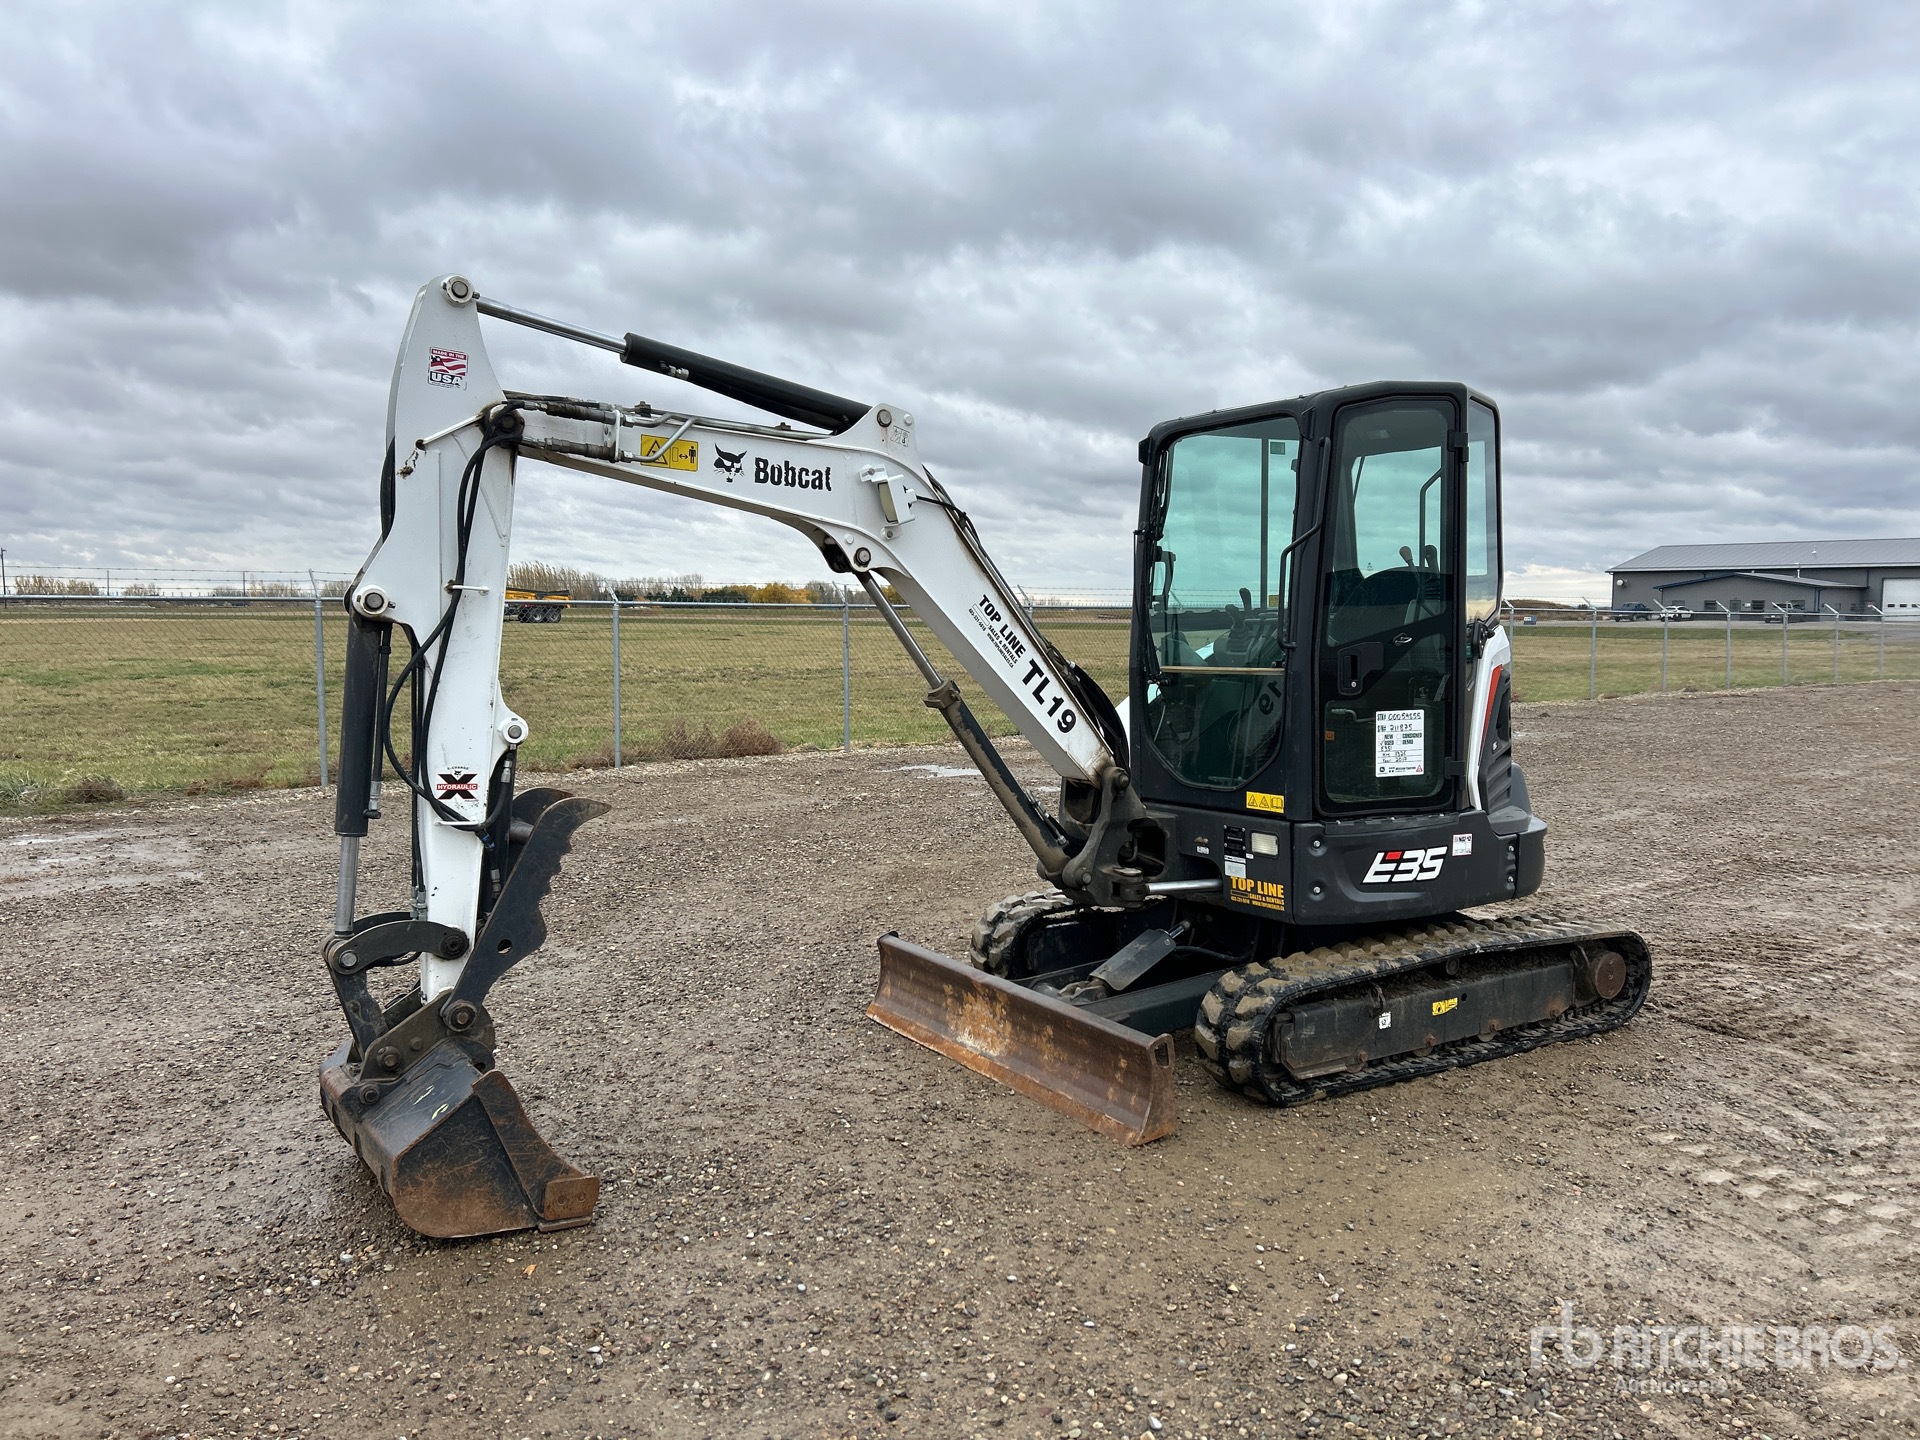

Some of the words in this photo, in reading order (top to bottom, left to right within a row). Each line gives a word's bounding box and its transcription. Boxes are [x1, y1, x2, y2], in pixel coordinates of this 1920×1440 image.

[432, 349, 448, 357] MADE
[431, 372, 462, 386] USA
[754, 457, 832, 492] Bobcat
[979, 594, 1002, 623] TOP
[1000, 624, 1026, 658] LINE
[988, 625, 1001, 642] SALES
[1002, 643, 1018, 664] RENTALS
[1022, 658, 1076, 734] TL19
[1362, 846, 1448, 883] E35
[1230, 876, 1254, 892] TOP
[1257, 880, 1284, 898] LINE
